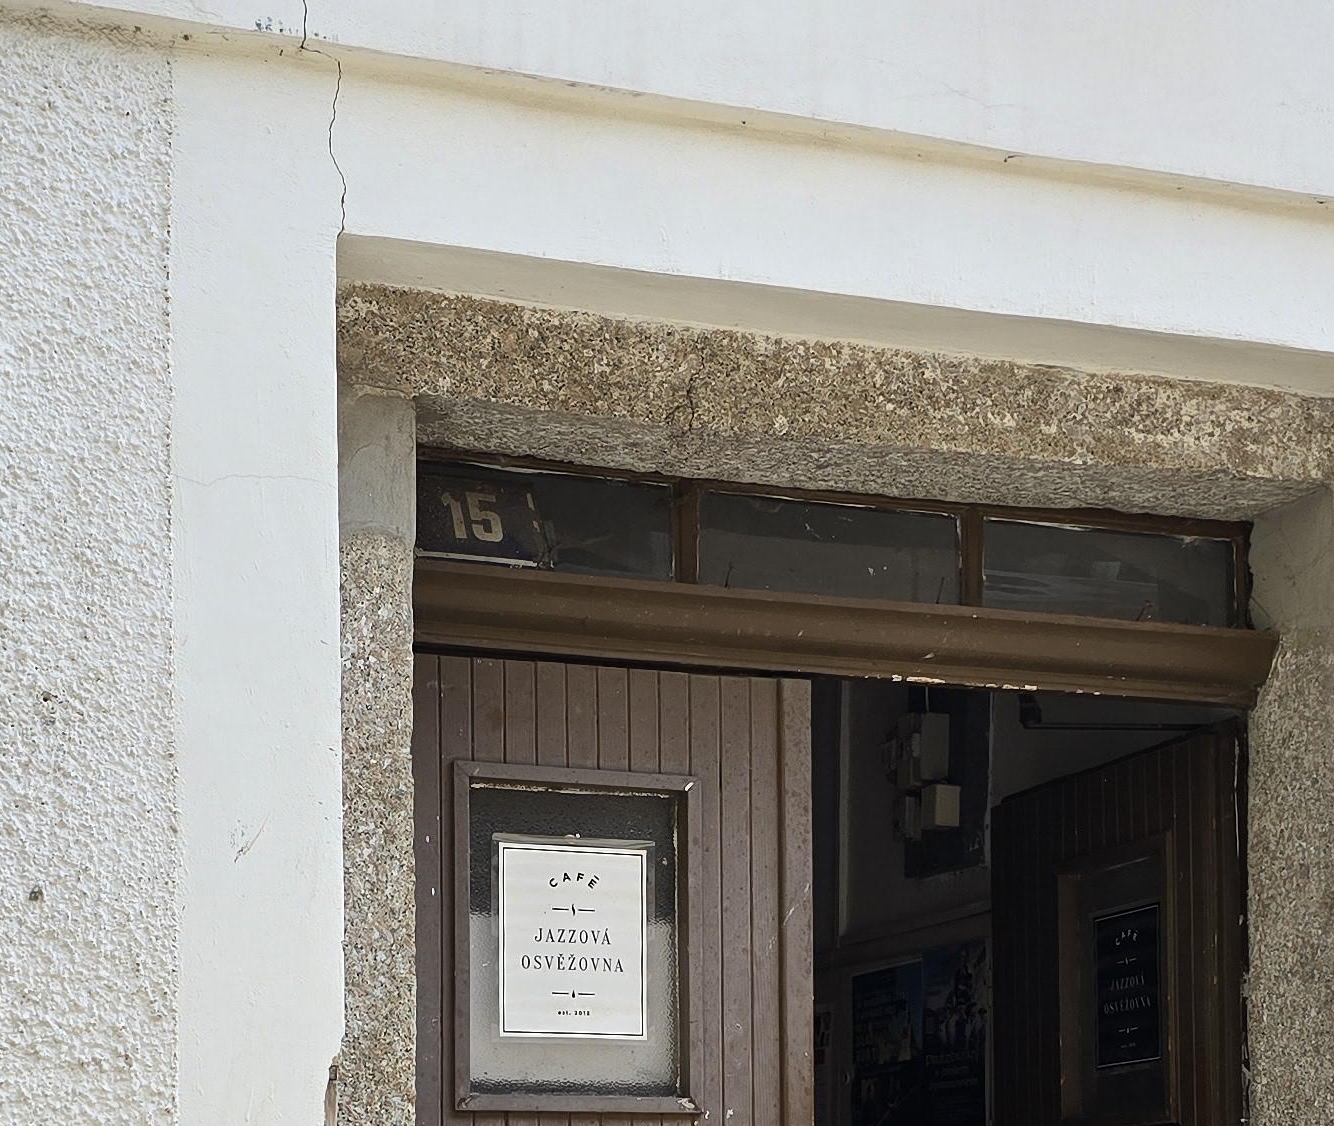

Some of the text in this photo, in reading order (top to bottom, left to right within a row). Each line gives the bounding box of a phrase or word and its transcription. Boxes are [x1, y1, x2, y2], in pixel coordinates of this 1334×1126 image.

[441, 491, 503, 542] 15
[534, 927, 611, 945] JAZZOVÁ
[521, 953, 624, 973] OSVĚŽOVNA
